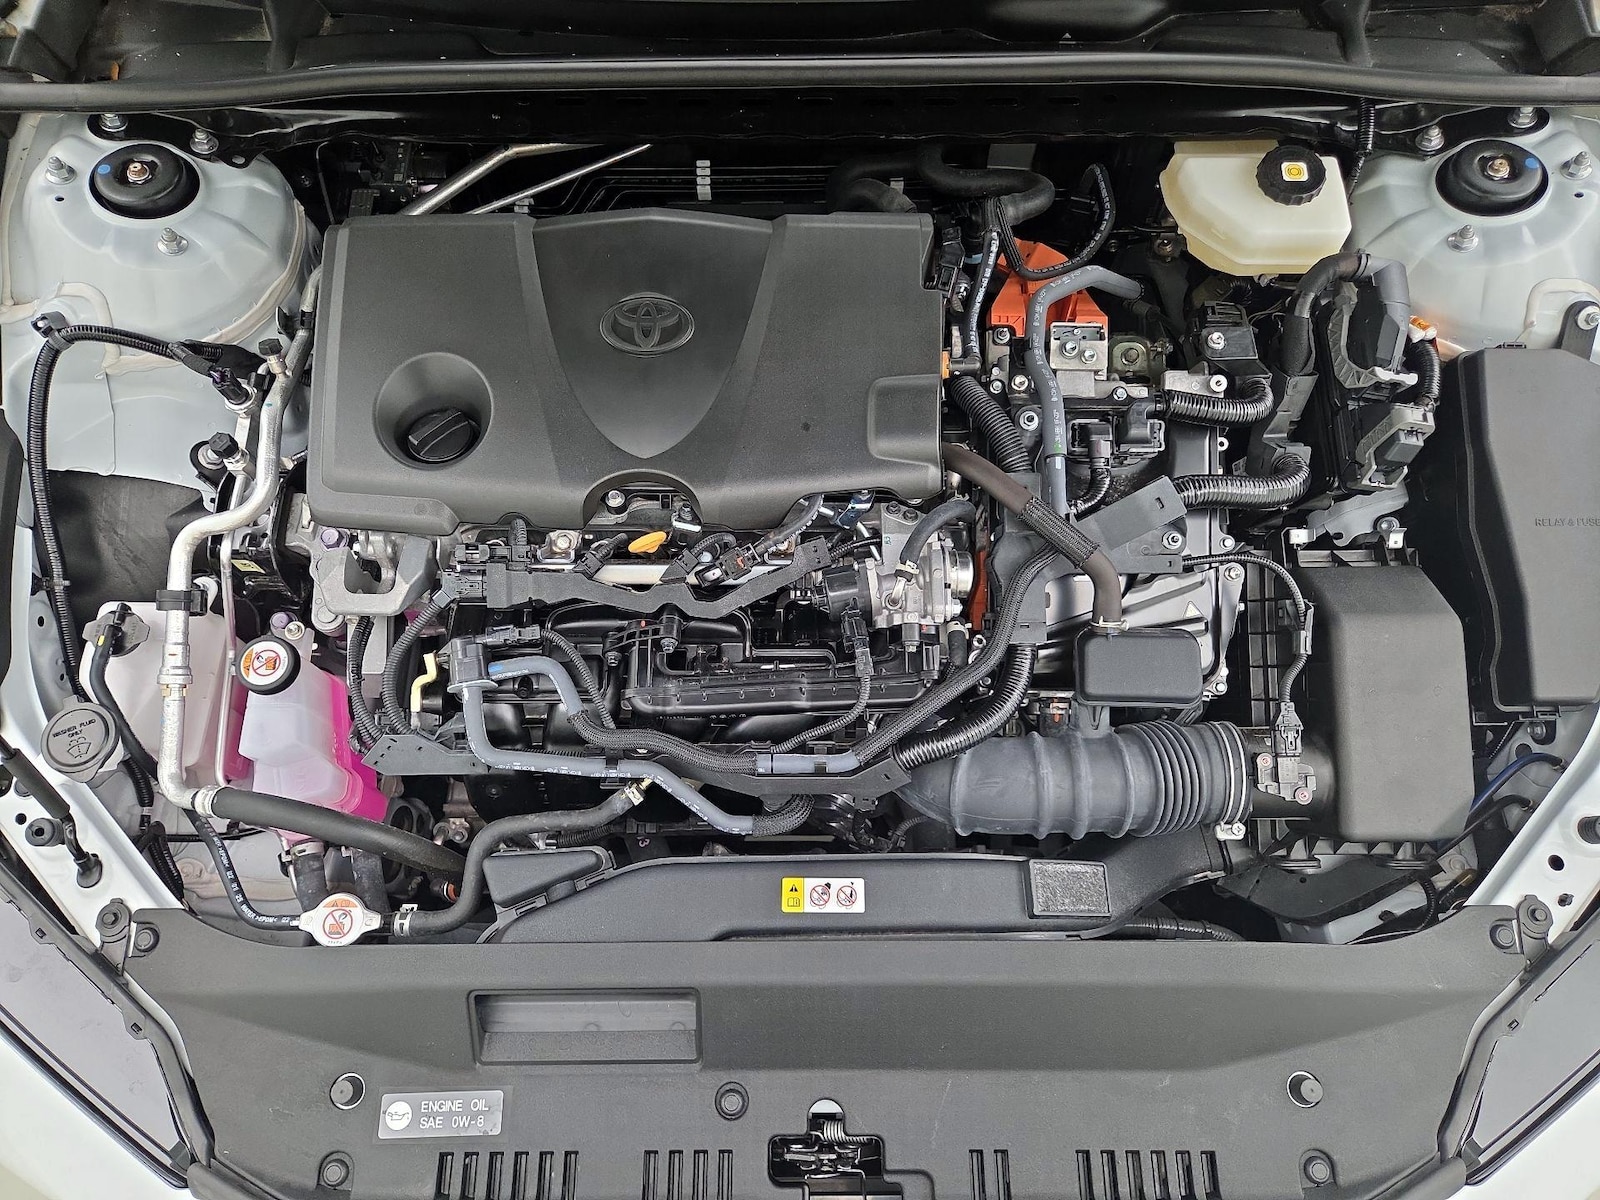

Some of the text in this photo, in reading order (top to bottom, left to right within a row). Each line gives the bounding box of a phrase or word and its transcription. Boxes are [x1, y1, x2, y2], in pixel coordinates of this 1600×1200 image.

[1535, 517, 1565, 527] RELAY
[1567, 518, 1575, 527] &
[52, 718, 96, 738] WASHER FLUID
[67, 729, 83, 738] ONLY
[421, 1099, 489, 1112] ENGINE OIL
[419, 1115, 485, 1129] SAE 0W-8
